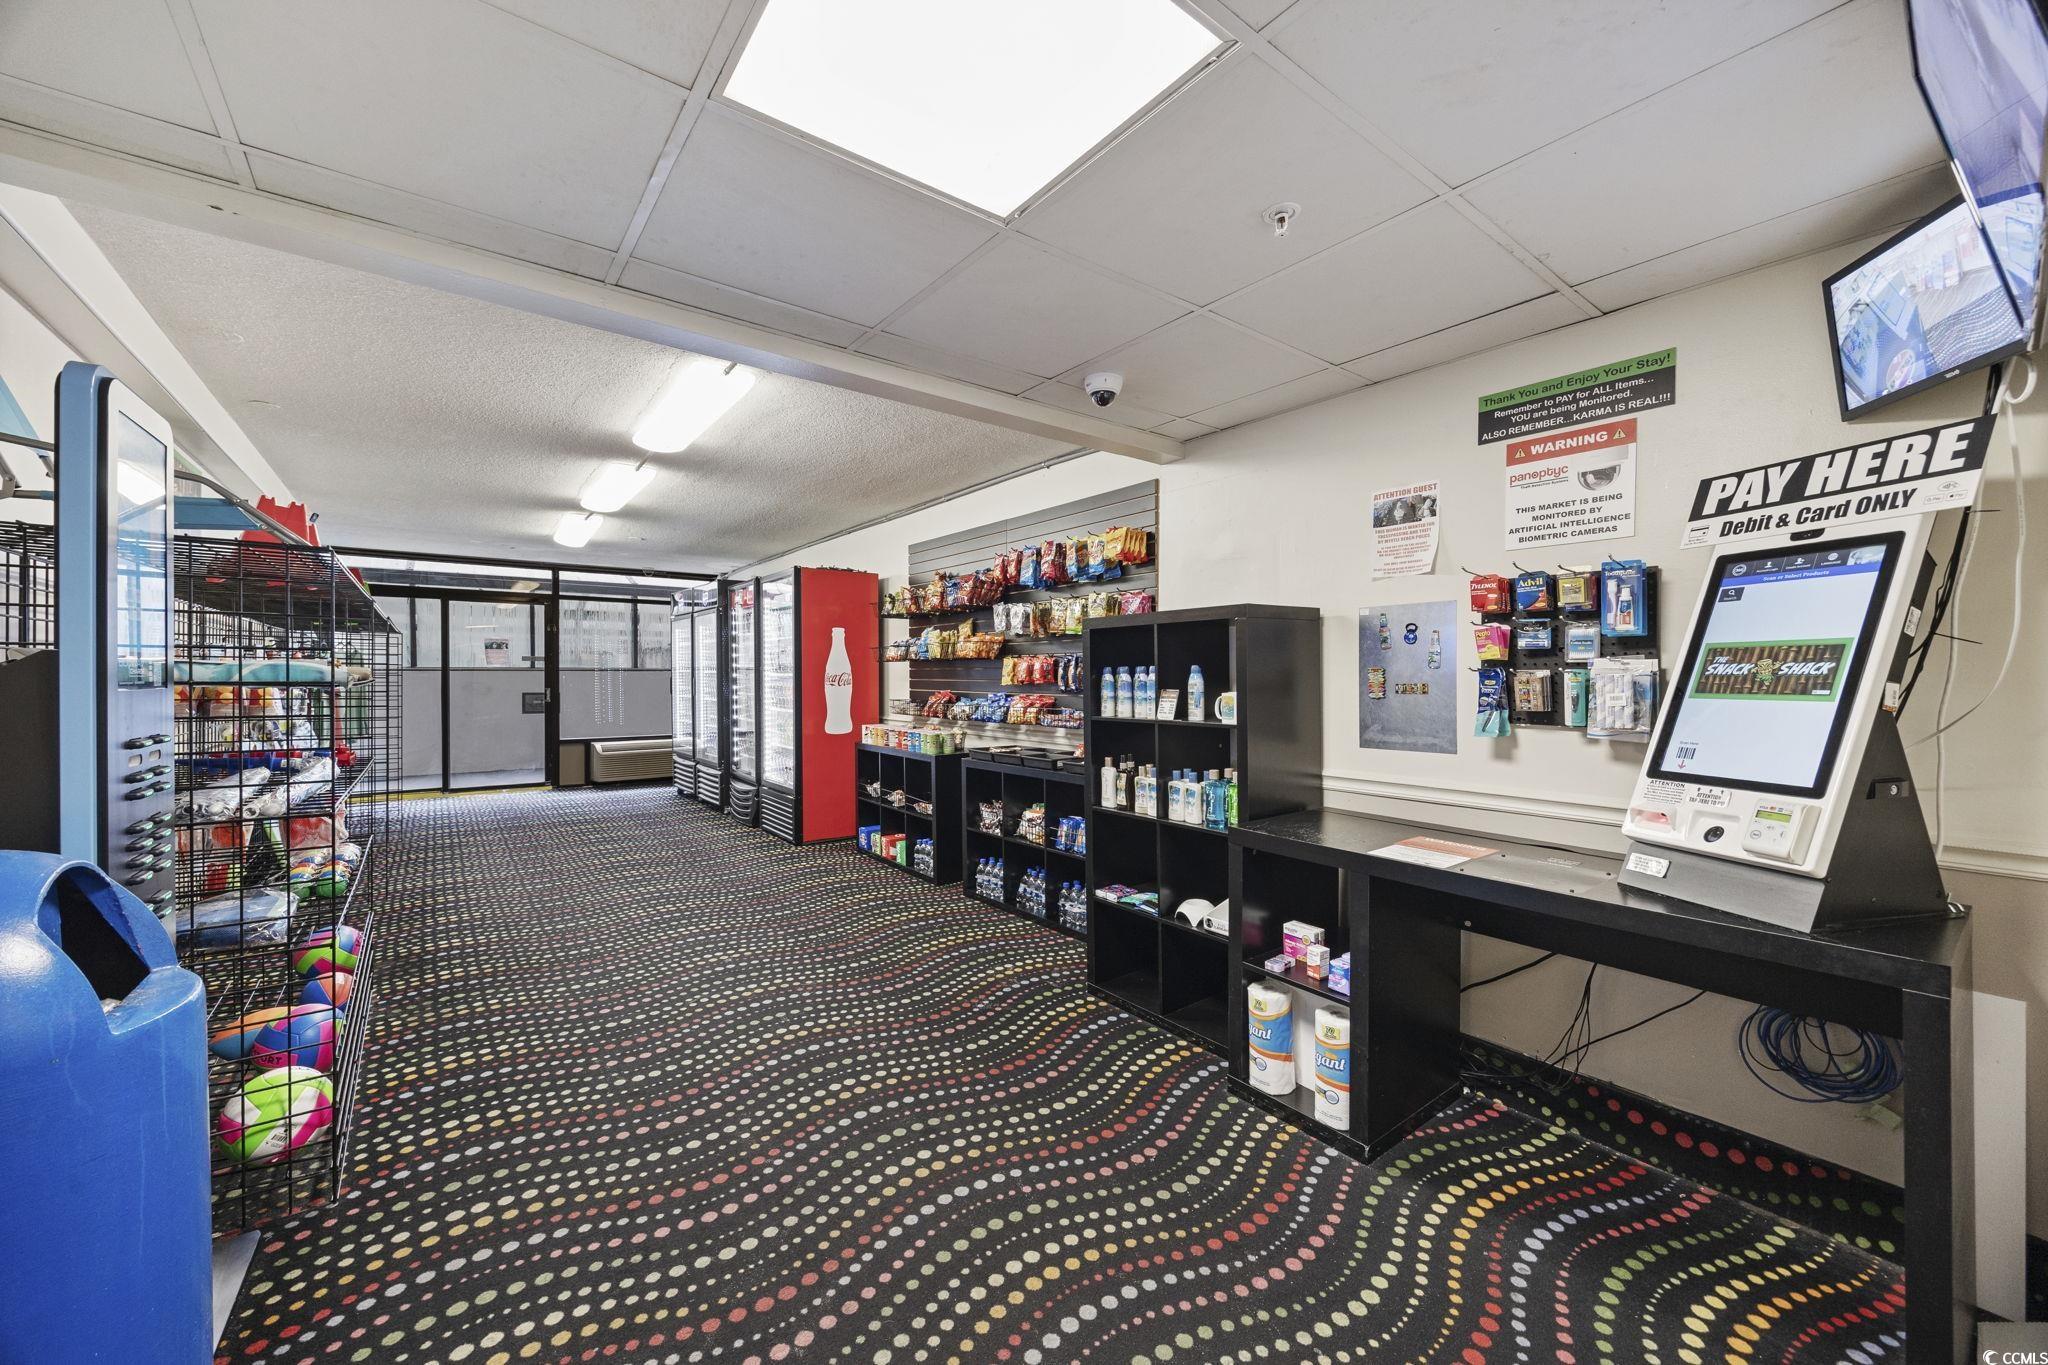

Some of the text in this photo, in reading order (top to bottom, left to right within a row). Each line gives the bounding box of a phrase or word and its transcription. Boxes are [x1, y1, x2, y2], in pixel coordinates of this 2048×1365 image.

[1483, 353, 1671, 408] Thank You and Enjoy Your Stay!
[1494, 376, 1654, 419] Remember to PAY for ALL Items...
[1511, 390, 1633, 423] YOU are being Monitored.
[1482, 428, 1507, 442] ALSO
[1614, 401, 1626, 412] IS
[1628, 393, 1671, 410] REAL!!!
[1530, 431, 1608, 455] WARNING
[1509, 465, 1569, 486] panoptyc
[1701, 422, 1976, 517] PAY HERE
[1373, 483, 1438, 501] ATTENTION GUEST
[1515, 493, 1623, 515] THIS MARKET IS BEING
[1531, 506, 1603, 522] MONITORED BY
[1719, 516, 1774, 538] Debit
[1774, 513, 1791, 528] &
[1795, 499, 1849, 525] Card
[1854, 488, 1918, 515] ONLY
[1508, 513, 1631, 535] ARTIFICIAL INTELLIGENCE
[1518, 525, 1618, 543] BIOMETRIC CAMERAS
[1519, 577, 1543, 588] Advil
[1803, 570, 1830, 578] Products
[1470, 582, 1498, 590] TYLENOL
[1705, 661, 1837, 676] SNACK SHACK
[1713, 656, 1730, 664] THE
[1650, 779, 1686, 788] ATTENTION
